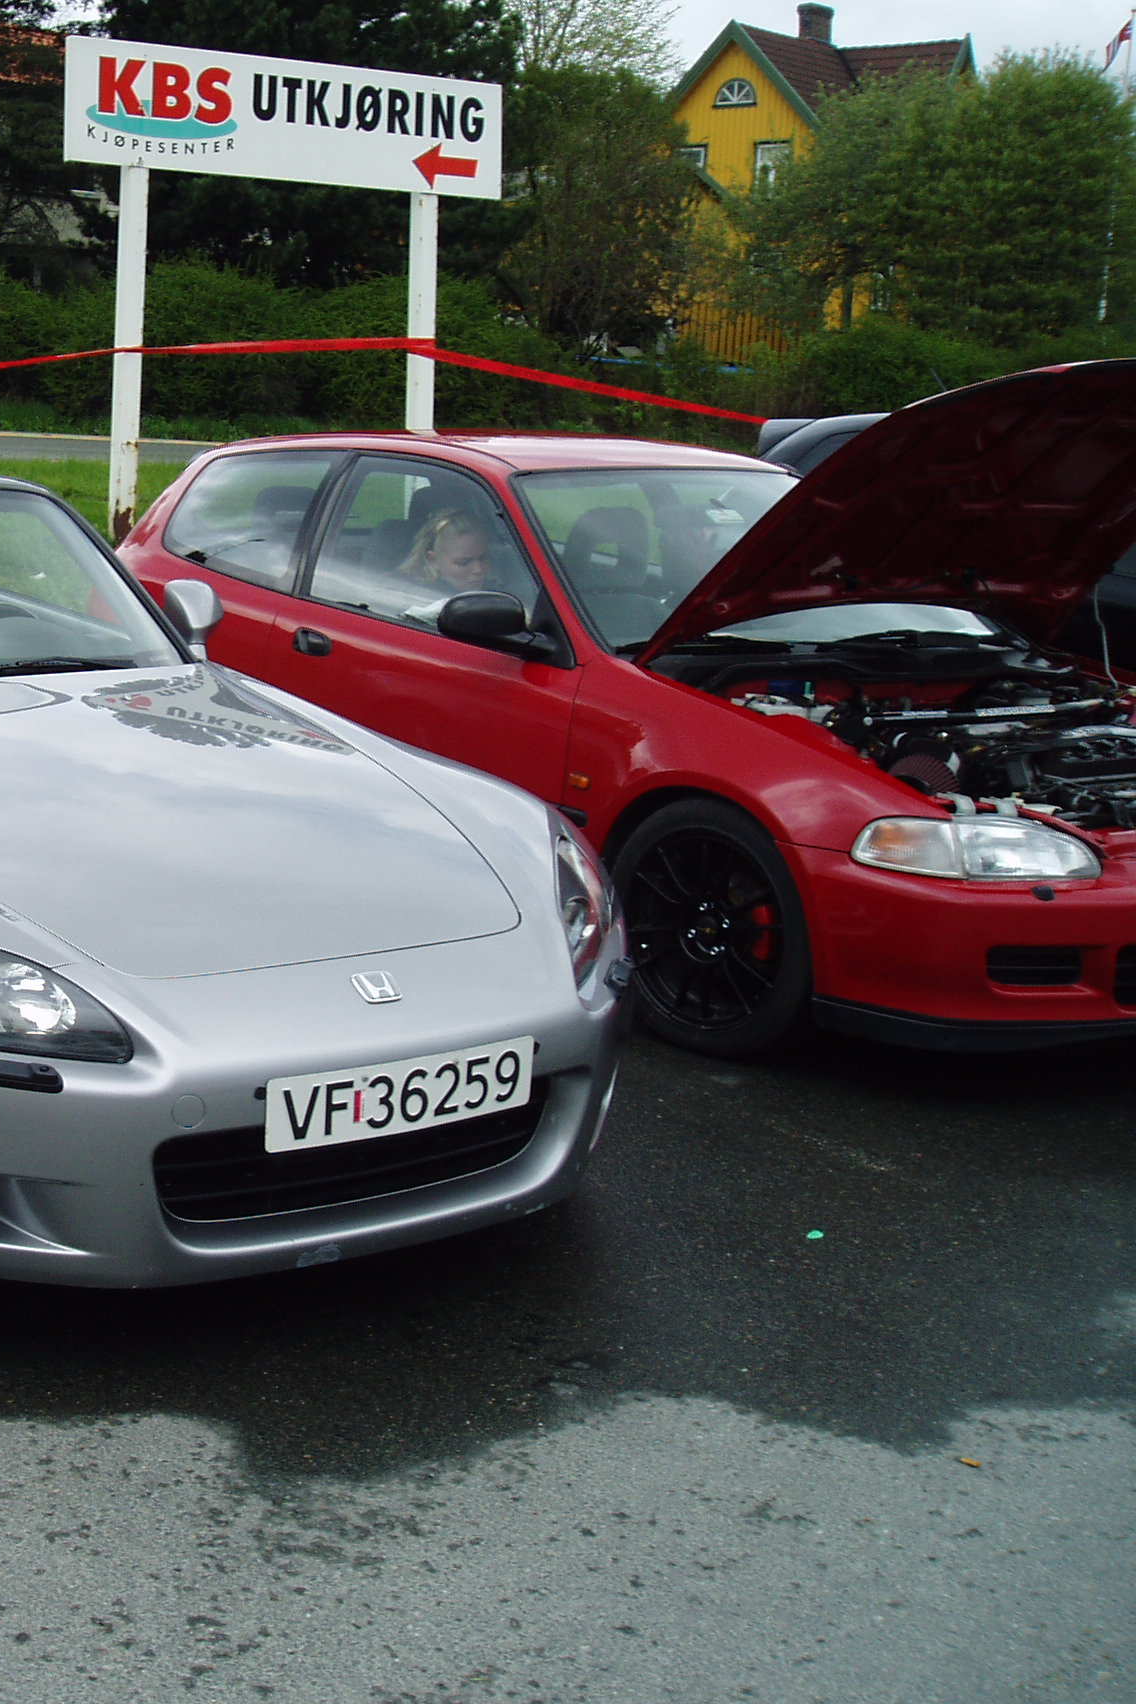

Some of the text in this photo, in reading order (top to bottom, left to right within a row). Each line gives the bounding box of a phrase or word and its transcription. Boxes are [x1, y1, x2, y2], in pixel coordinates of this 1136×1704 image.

[97, 55, 232, 124] KBS
[251, 72, 485, 143] UTKJØRING
[87, 123, 235, 155] KJØPESENTER
[366, 1050, 521, 1129] 36259
